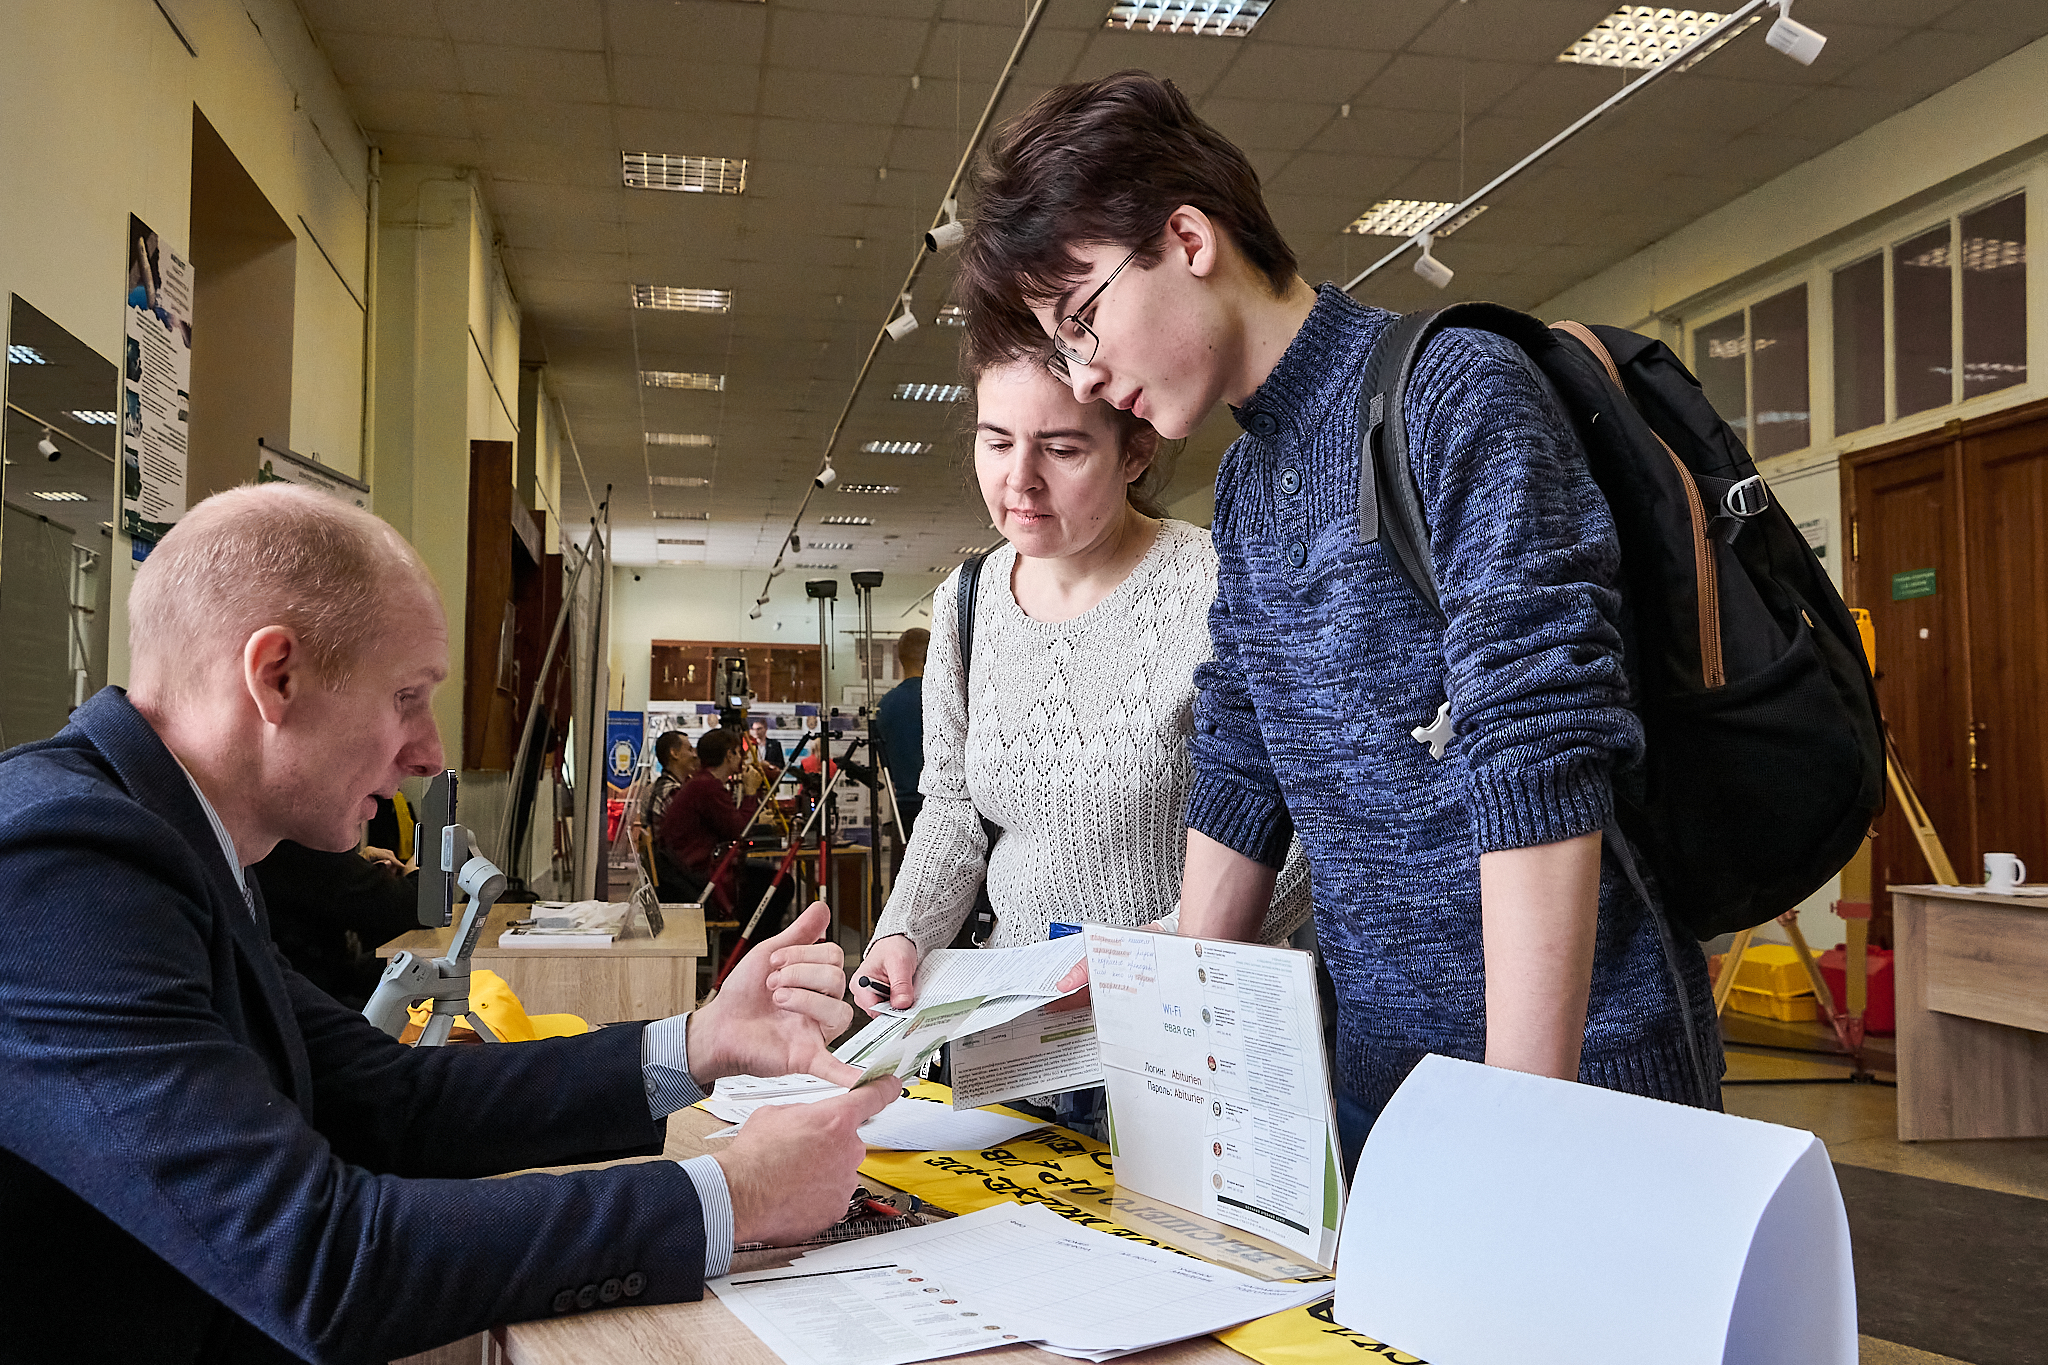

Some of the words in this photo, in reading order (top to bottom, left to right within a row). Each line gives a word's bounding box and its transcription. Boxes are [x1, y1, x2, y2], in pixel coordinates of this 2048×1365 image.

[1162, 1003, 1182, 1017] Wi-Fi
[1163, 1022, 1182, 1034] евая
[1145, 1062, 1167, 1076] Логин:
[1147, 1080, 1173, 1096] Пароль:
